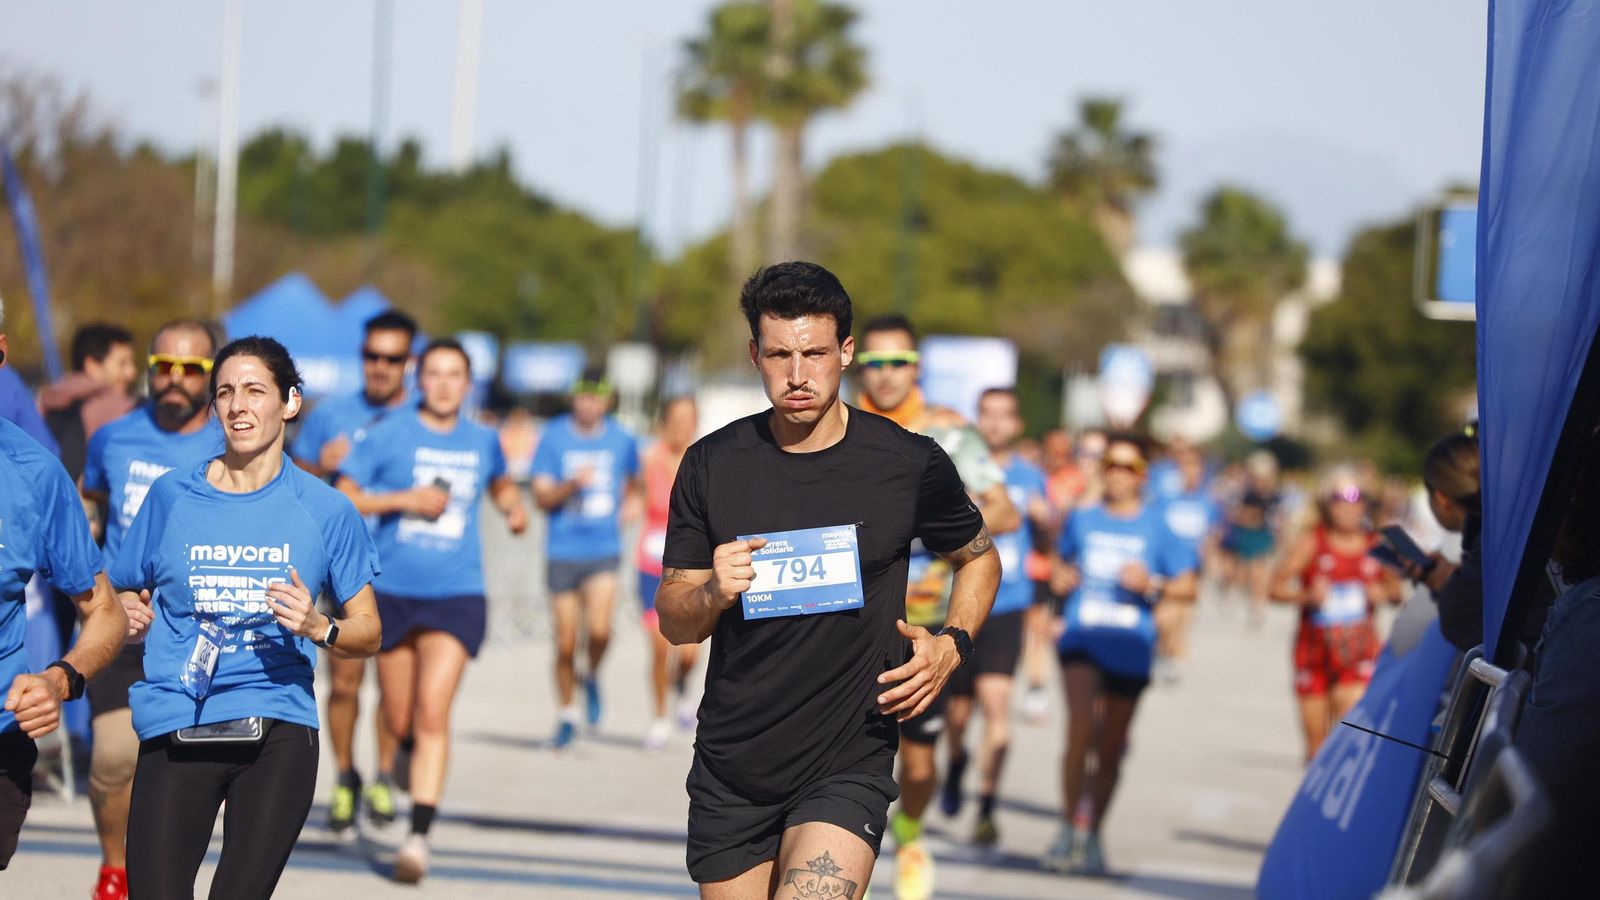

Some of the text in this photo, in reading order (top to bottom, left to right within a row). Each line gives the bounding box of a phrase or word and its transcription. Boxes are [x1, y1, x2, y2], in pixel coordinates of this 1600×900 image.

[190, 543, 290, 566] mayoral
[760, 545, 794, 556] Solidaria
[772, 556, 827, 585] 794
[197, 588, 276, 602] MAKE
[746, 593, 772, 604] 10KM
